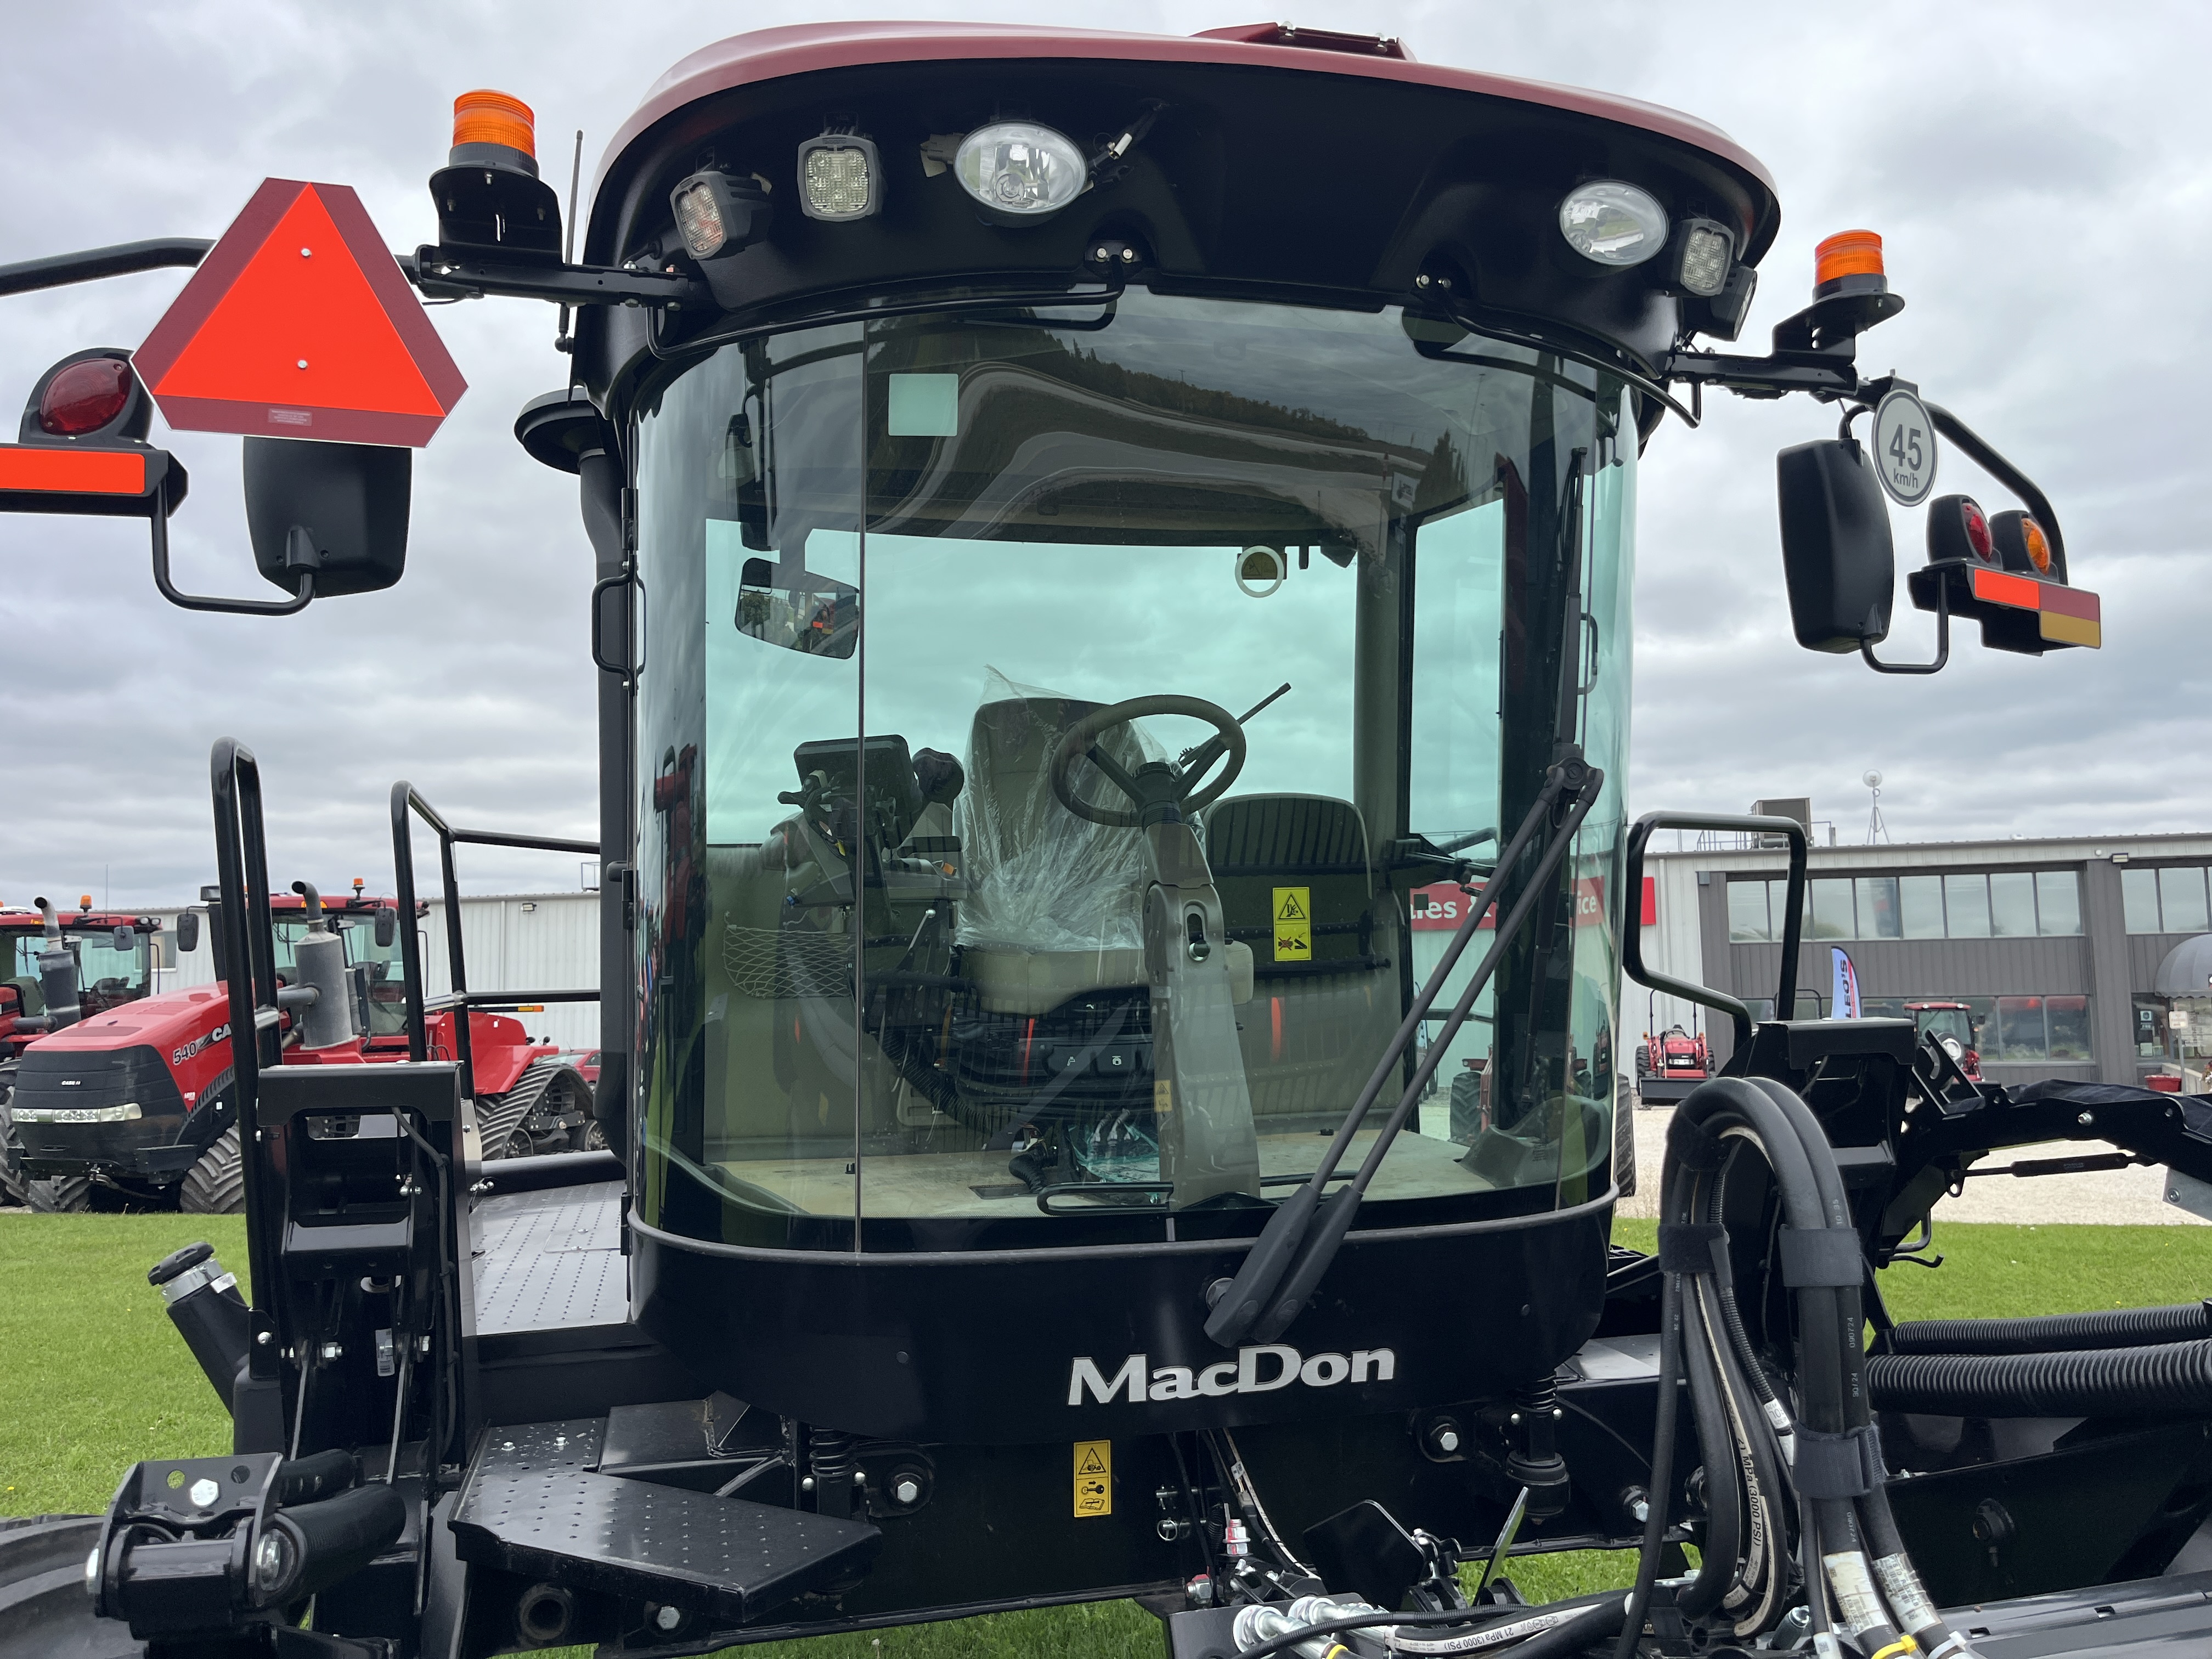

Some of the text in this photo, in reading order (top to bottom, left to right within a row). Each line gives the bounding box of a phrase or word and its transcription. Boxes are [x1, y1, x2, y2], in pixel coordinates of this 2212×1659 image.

[1889, 424, 1922, 471] 45
[1894, 469, 1918, 488] km/h
[173, 1041, 197, 1065] 540
[1068, 1344, 1394, 1405] MacDon
[1737, 1438, 1761, 1546] 21 MPa (3000 PSI)
[1463, 1636, 1485, 1647] (3000
[1485, 1630, 1503, 1641] MPa
[1504, 1627, 1514, 1637] 21
[1444, 1641, 1462, 1651] PSI)
